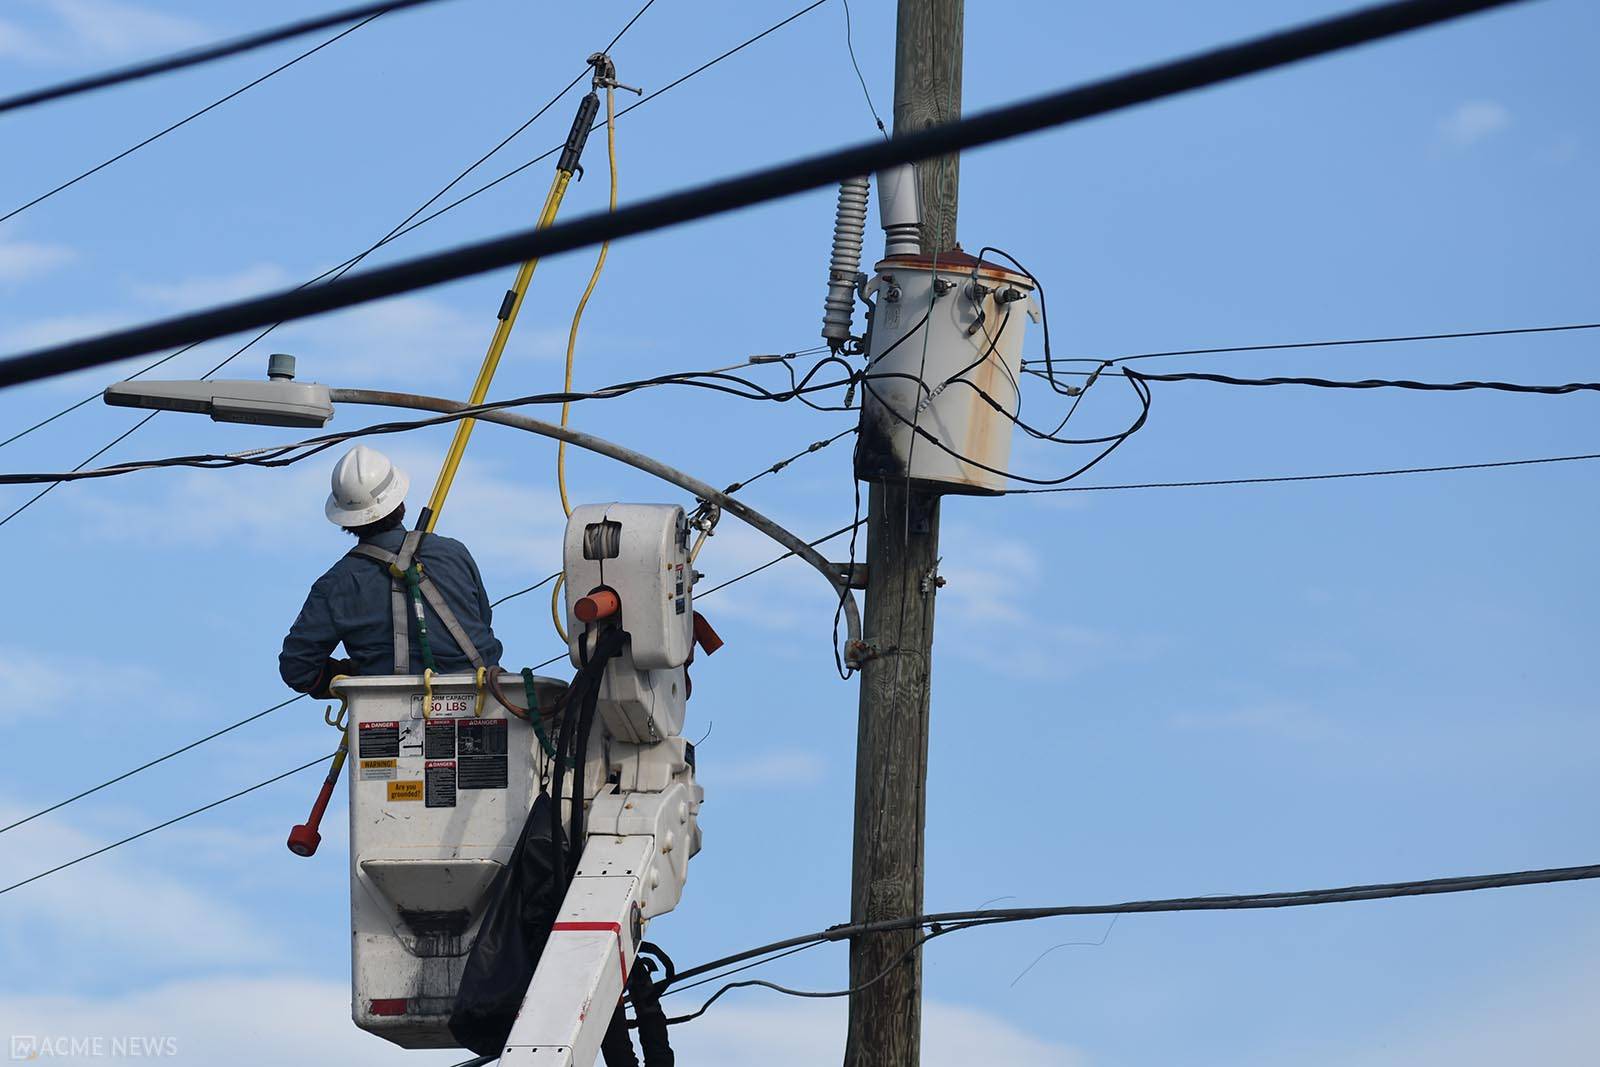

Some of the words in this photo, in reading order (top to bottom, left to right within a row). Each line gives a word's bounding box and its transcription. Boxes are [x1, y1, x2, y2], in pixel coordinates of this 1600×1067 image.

[446, 702, 467, 712] LBS
[365, 760, 393, 768] WARNING!
[406, 784, 417, 792] you
[391, 790, 421, 800] grounded?
